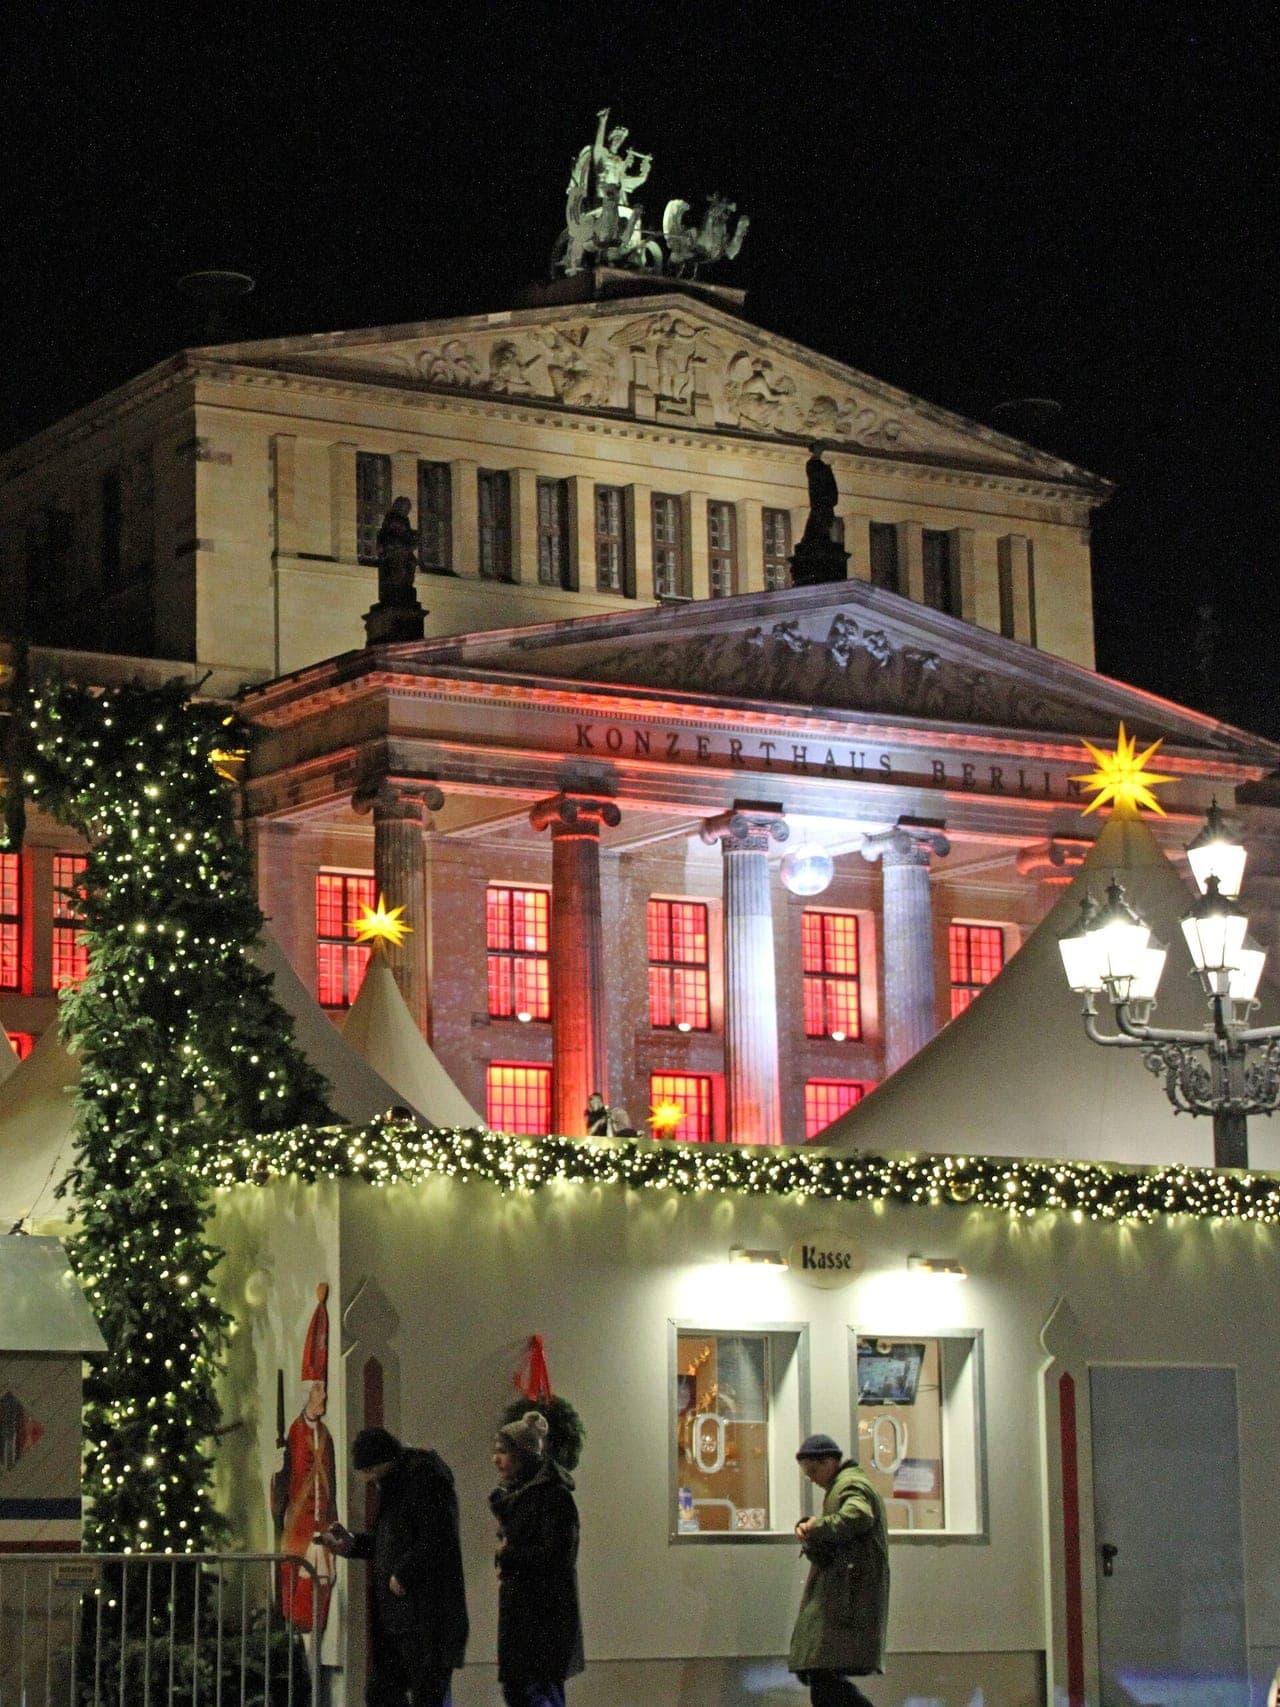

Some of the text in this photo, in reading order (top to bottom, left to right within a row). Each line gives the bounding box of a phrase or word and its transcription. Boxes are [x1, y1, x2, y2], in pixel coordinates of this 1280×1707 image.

[575, 723, 892, 777] KONZERTHAUS
[931, 759, 1082, 797] BERLIN
[801, 1245, 852, 1270] Kasse
